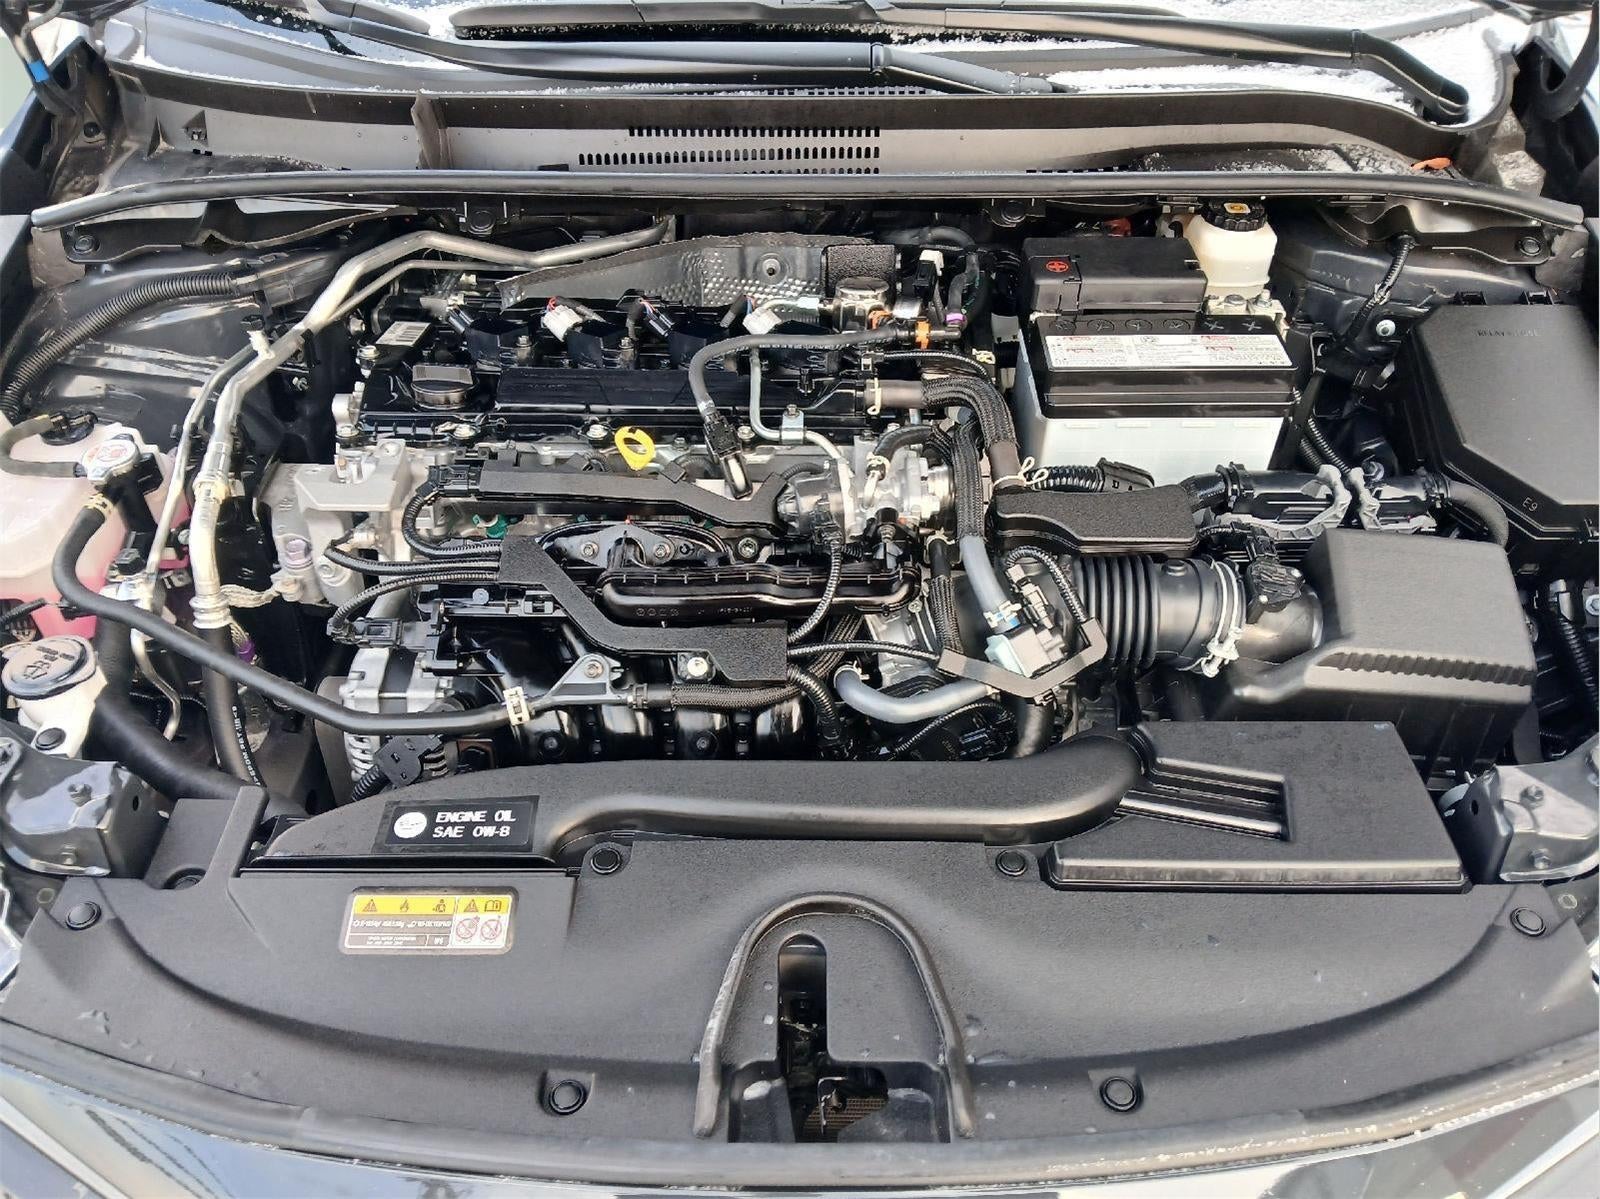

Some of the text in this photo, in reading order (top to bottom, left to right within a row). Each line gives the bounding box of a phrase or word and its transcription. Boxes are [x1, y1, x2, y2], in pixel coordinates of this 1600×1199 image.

[1522, 497, 1538, 512] E9
[435, 810, 516, 823] ENGINE OIL
[432, 826, 465, 838] SAE
